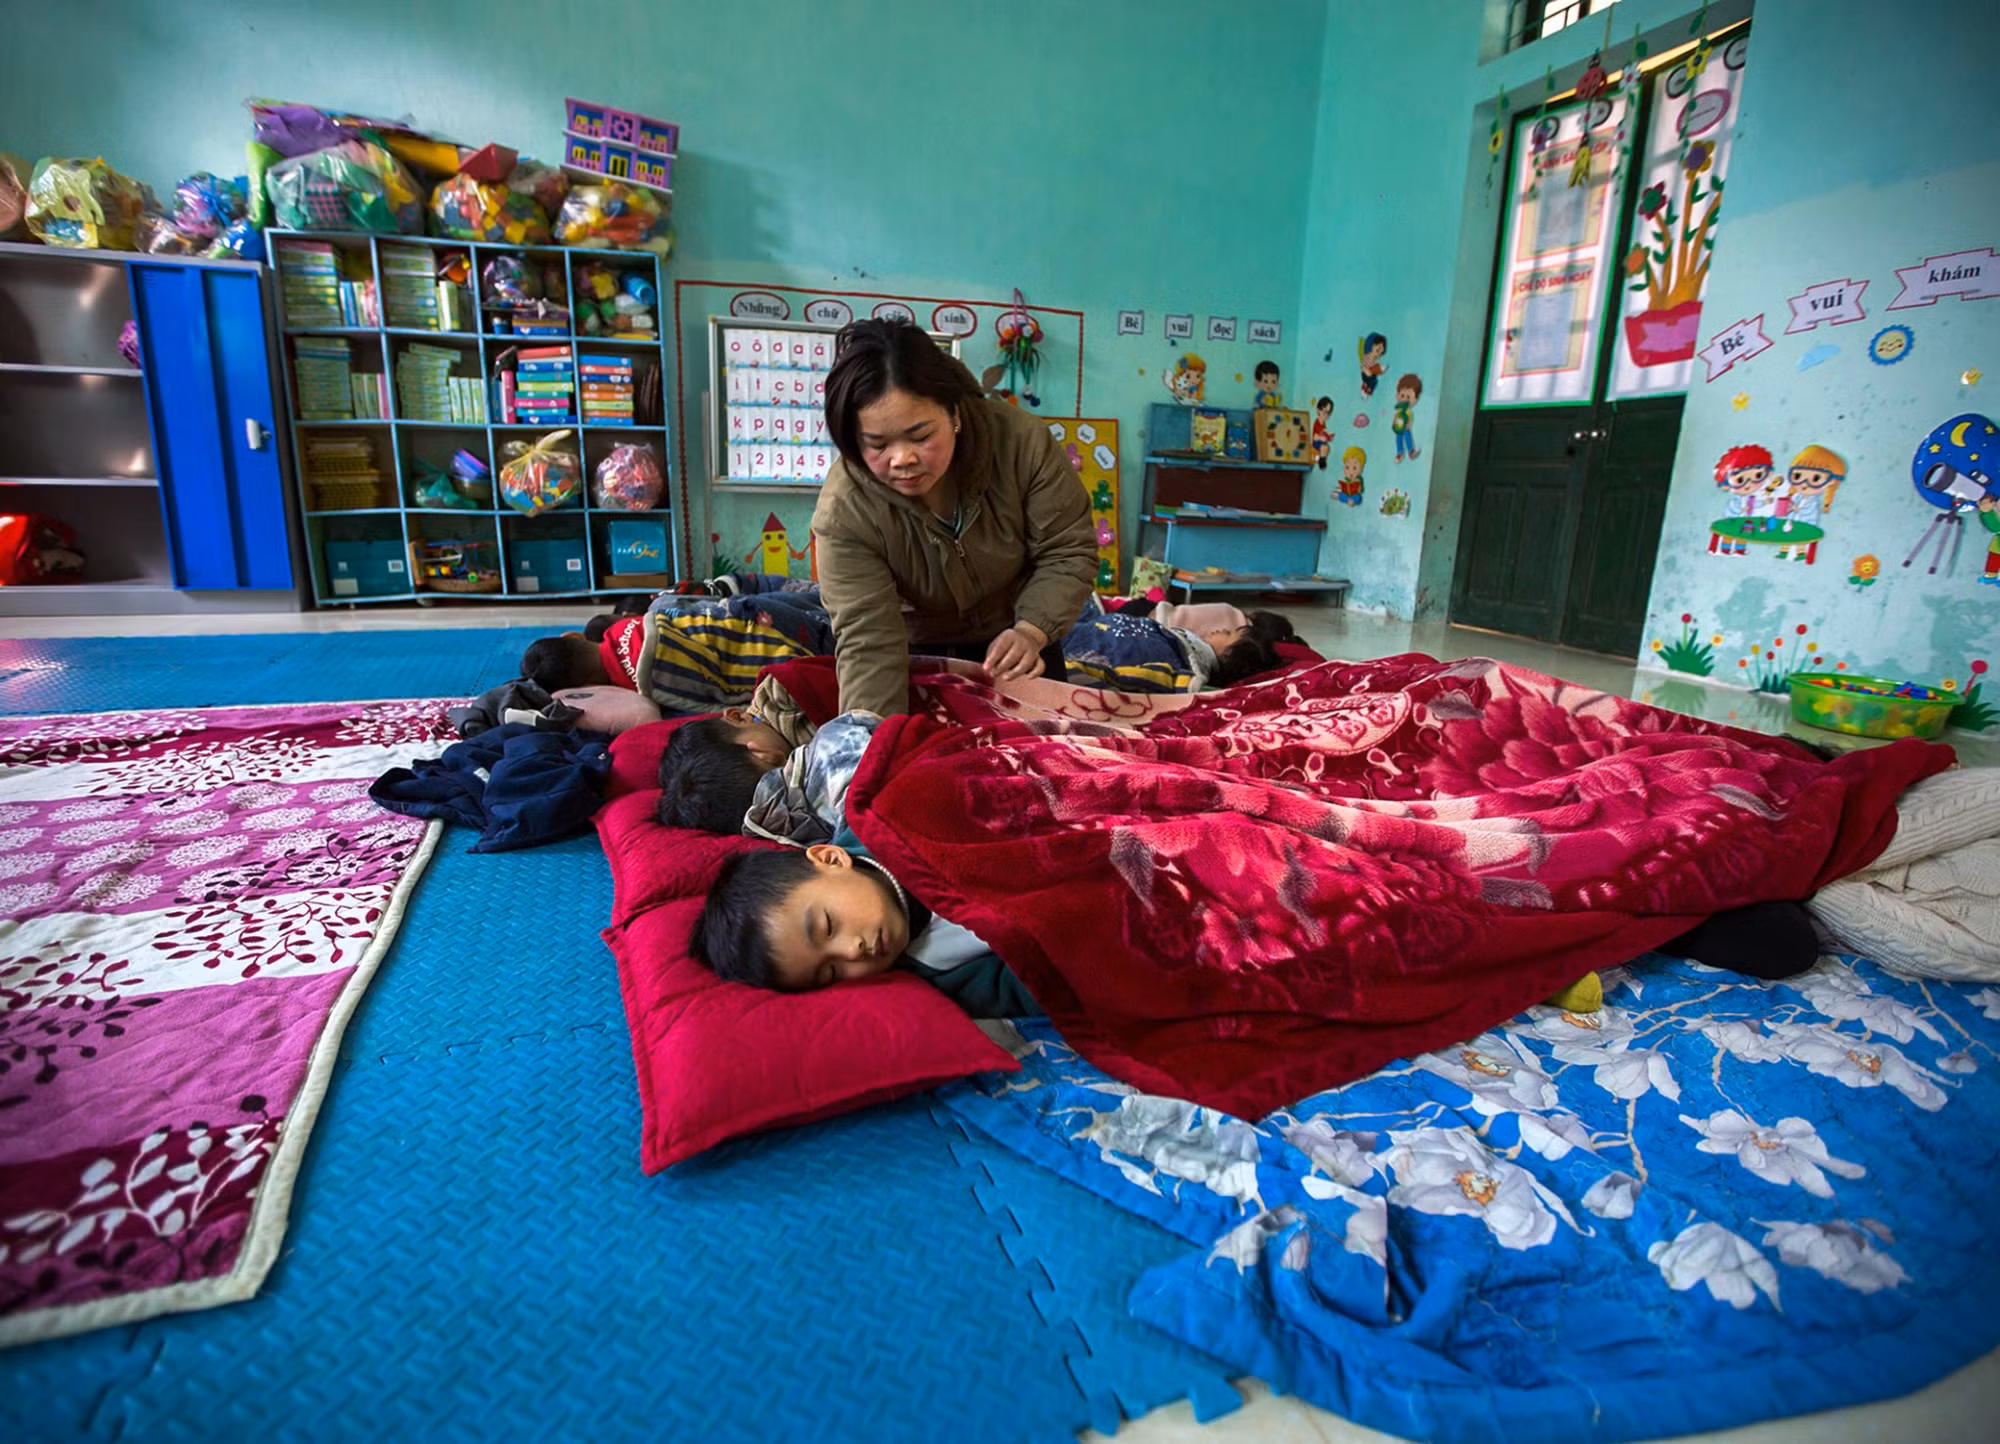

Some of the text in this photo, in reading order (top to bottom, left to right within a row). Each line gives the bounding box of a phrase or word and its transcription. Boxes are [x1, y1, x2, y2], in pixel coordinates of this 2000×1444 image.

[739, 299, 780, 317] Những
[817, 306, 839, 319] chữ
[1719, 264, 1981, 355] Bé vui khám
[1125, 316, 1276, 338] Bé vui đọc sách
[774, 381, 785, 391] c
[794, 379, 804, 392] b
[733, 415, 824, 433] k p q g y
[736, 452, 825, 467] 1 2 3 4 5
[616, 619, 641, 655] School
